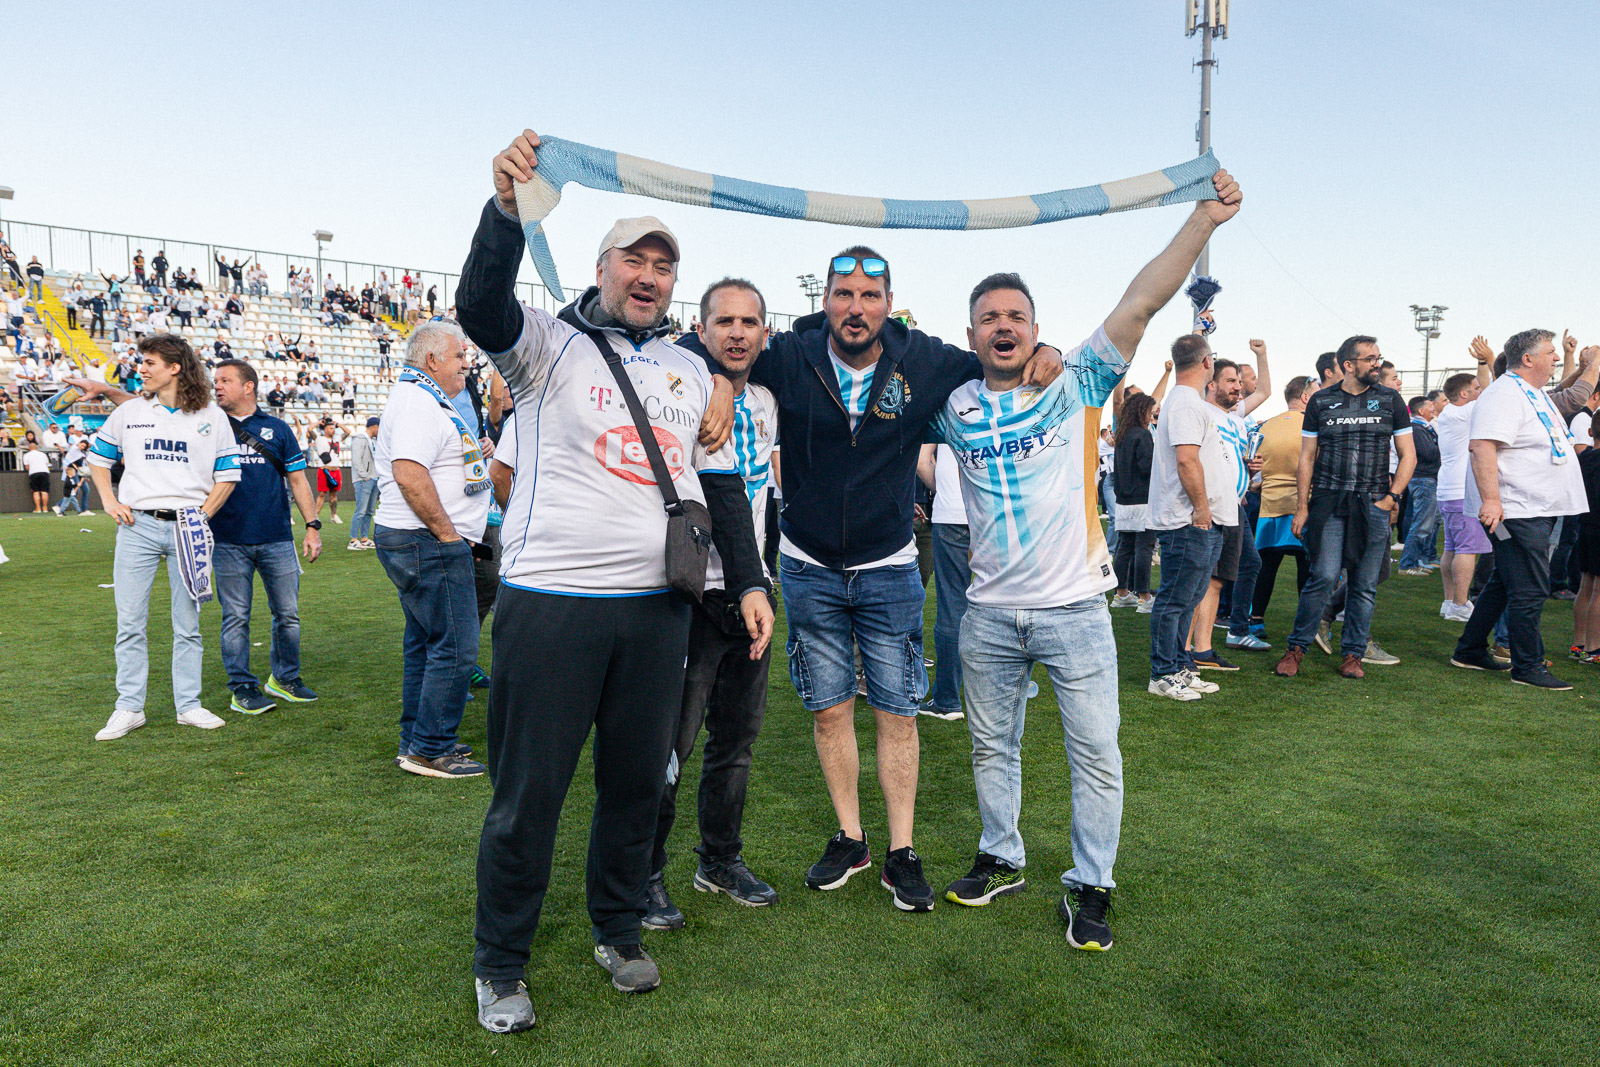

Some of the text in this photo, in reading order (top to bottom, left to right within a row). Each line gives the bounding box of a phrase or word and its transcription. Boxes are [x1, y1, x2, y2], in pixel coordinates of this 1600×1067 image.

[623, 355, 660, 367] LEGEA
[590, 386, 612, 412] T
[1336, 416, 1382, 425] FAVBET
[605, 432, 684, 472] Leo
[971, 432, 1048, 461] FAVBET
[145, 453, 190, 463] maziva
[240, 455, 266, 464] ziva
[186, 503, 208, 574] IJEKA
